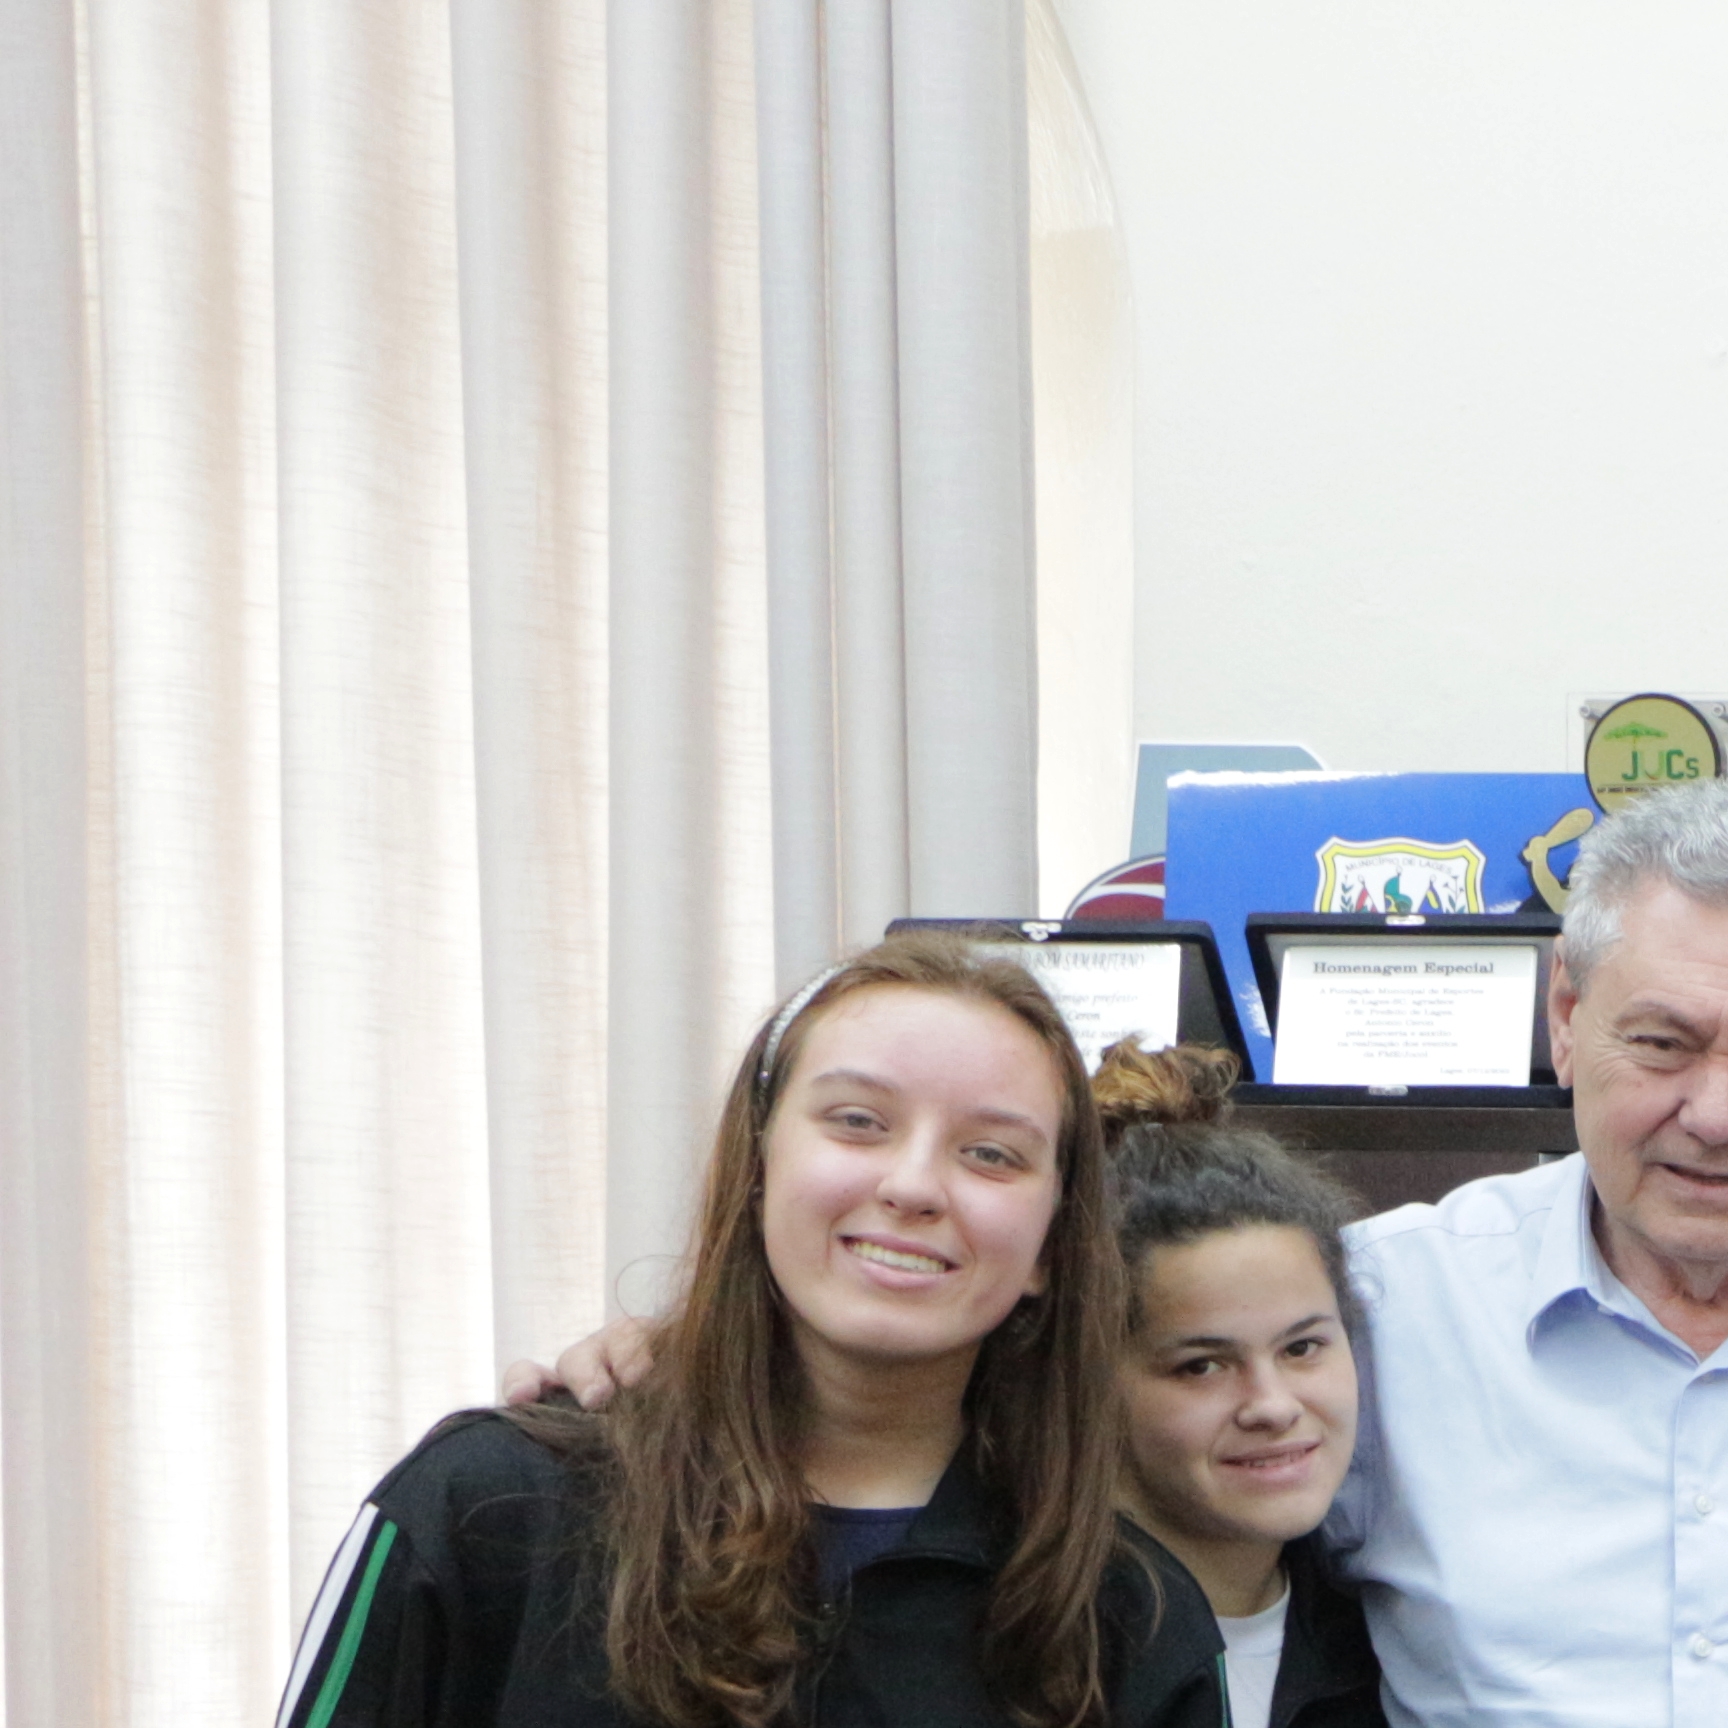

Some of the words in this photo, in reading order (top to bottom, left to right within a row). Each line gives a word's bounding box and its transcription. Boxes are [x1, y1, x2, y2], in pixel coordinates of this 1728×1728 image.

[1621, 749, 1700, 781] JUCs
[1402, 856, 1416, 866] DE
[1419, 857, 1453, 874] LAGES
[1313, 961, 1418, 976] Homenagem
[1424, 961, 1495, 976] Especial
